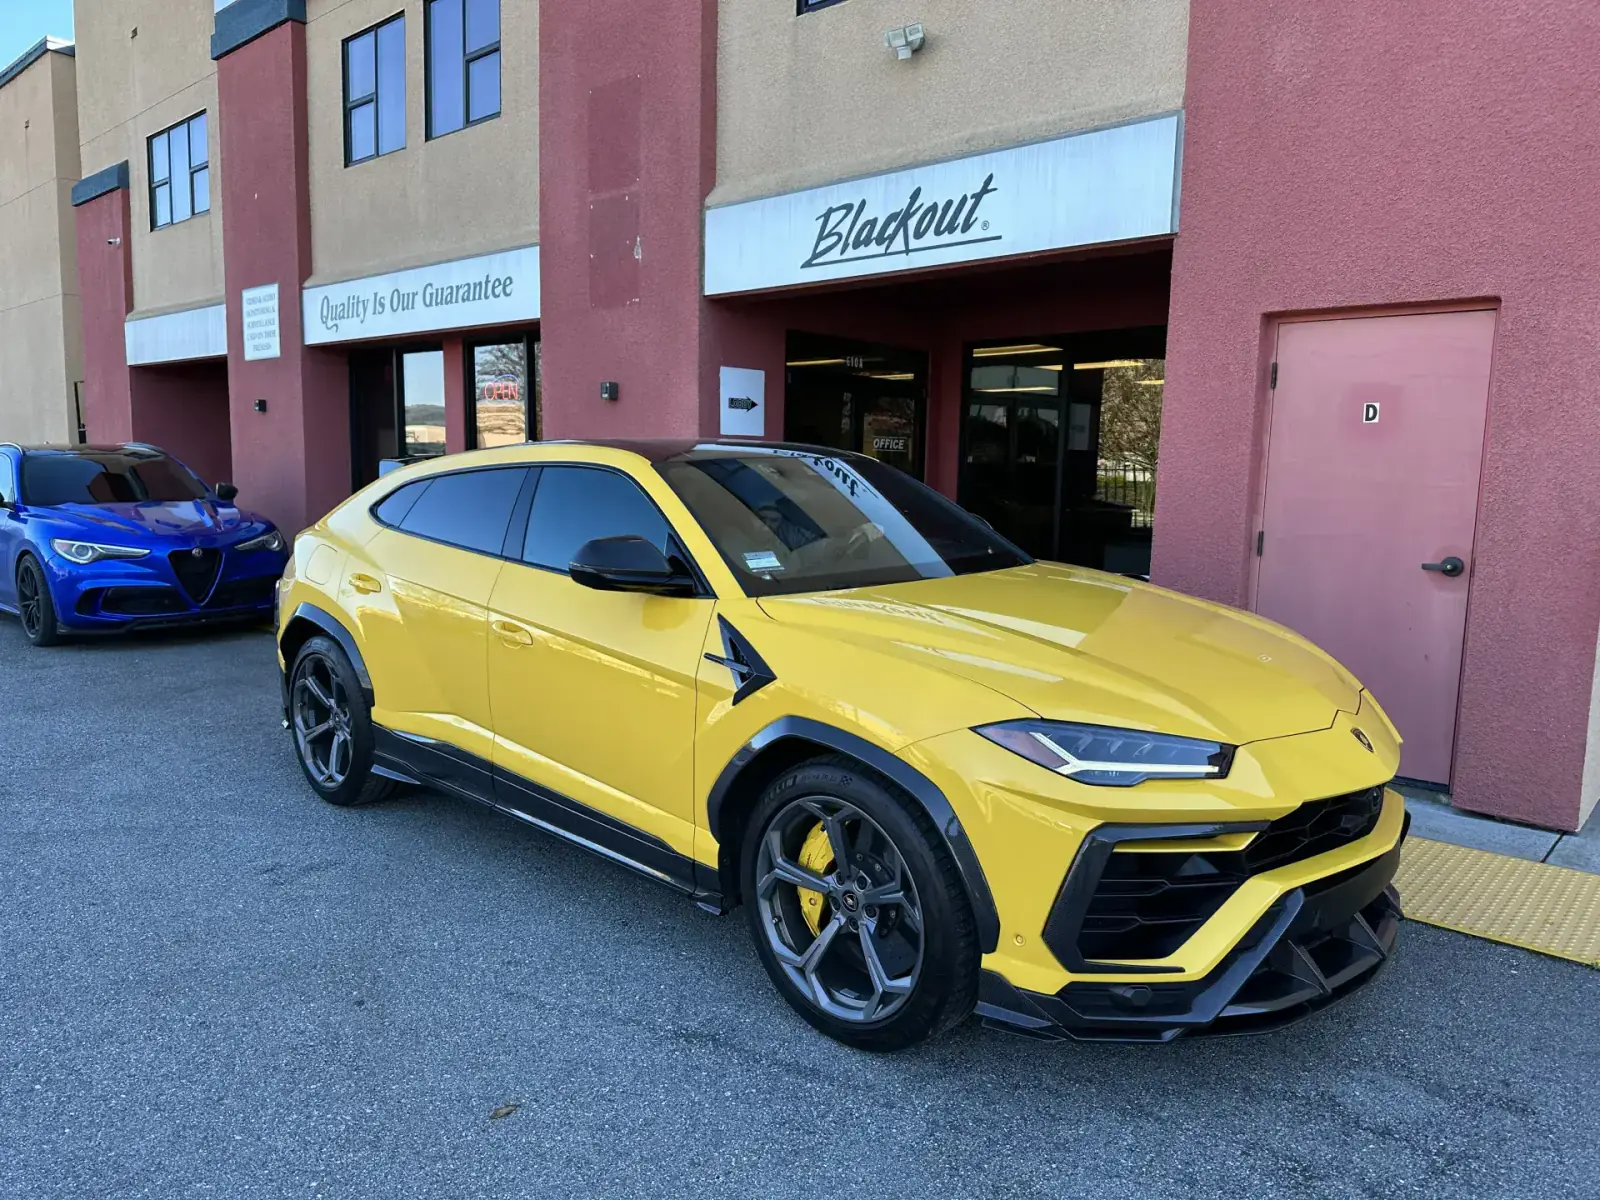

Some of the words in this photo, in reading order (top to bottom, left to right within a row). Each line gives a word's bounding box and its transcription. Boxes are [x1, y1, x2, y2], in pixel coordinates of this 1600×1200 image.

[800, 173, 998, 268] Blackout
[320, 295, 370, 333] Quality
[372, 291, 386, 315] Is
[390, 288, 419, 313] Our
[422, 273, 514, 308] Guarantee
[484, 381, 519, 401] OPEN
[1365, 403, 1378, 422] D
[873, 438, 905, 450] OFFICE
